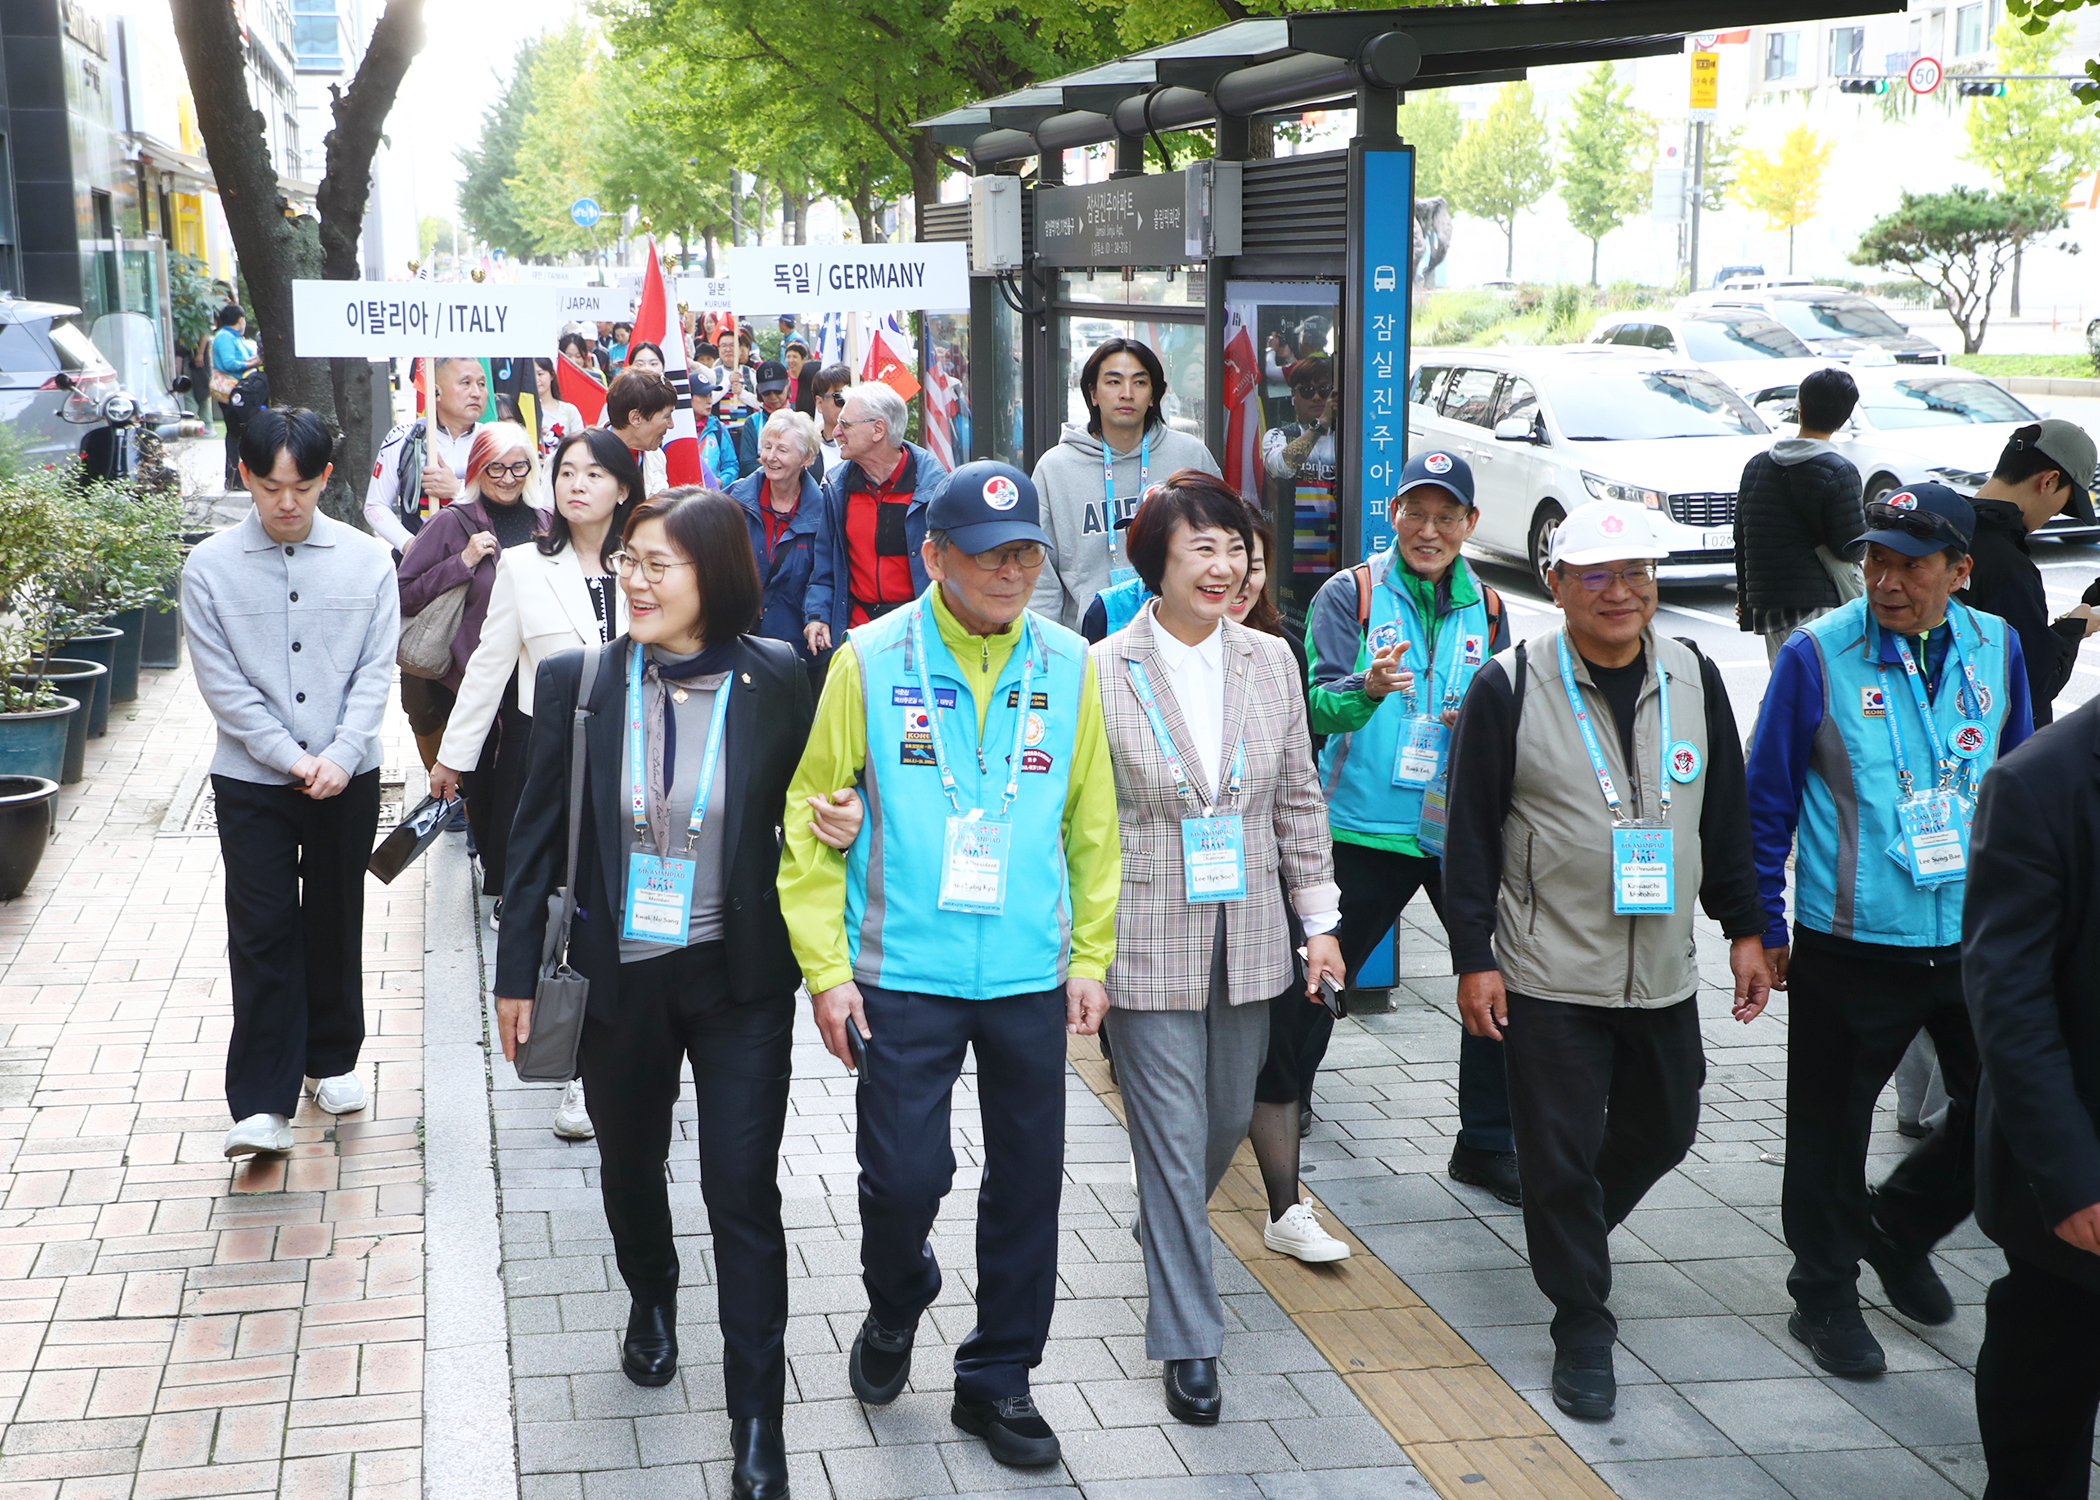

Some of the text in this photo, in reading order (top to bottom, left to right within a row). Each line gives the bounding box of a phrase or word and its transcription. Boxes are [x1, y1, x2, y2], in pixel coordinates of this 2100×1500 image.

[1915, 68, 1935, 84] 50
[1692, 110, 1716, 120] 200m
[1086, 189, 1134, 224] 잠실진주아파트
[1154, 207, 1181, 230] 올림픽회관
[547, 272, 569, 280] TAIWAN
[773, 262, 810, 294] 독일
[828, 262, 926, 290] GERMANY
[708, 282, 726, 296] 일본
[566, 297, 600, 310] JAPAN
[346, 303, 428, 336] 이탈리아
[448, 304, 508, 334] ITALY
[913, 620, 921, 632] THE
[916, 642, 925, 662] KOREA
[1898, 640, 1906, 651] THE
[1023, 669, 1031, 680] THE
[1563, 671, 1574, 689] KOREA
[919, 662, 934, 706] INTERNATIONAL
[1019, 692, 1028, 713] KOREA
[1141, 688, 1150, 699] THE
[1574, 699, 1582, 711] THE
[928, 706, 941, 738] WALKING
[1149, 707, 1164, 737] ASIANPIAD
[1885, 695, 1893, 713] KOREA
[1889, 713, 1901, 756] INTERNATIONAL
[1013, 714, 1025, 757] INTERNATIONAL
[1581, 719, 1596, 749] ASIANPIAD
[1923, 709, 1944, 758] WALKING FESTIVAL
[697, 686, 727, 806] KOREA INTERNATIONAL WALKING FESTIVAL
[935, 738, 946, 765] FESTIVAL
[1163, 744, 1172, 755] THE
[1595, 756, 1603, 767] THE
[650, 871, 685, 879] ASIANPIAD
[983, 884, 996, 892] Kyu
[635, 913, 651, 921] Kwak
[664, 917, 679, 925] Sang
